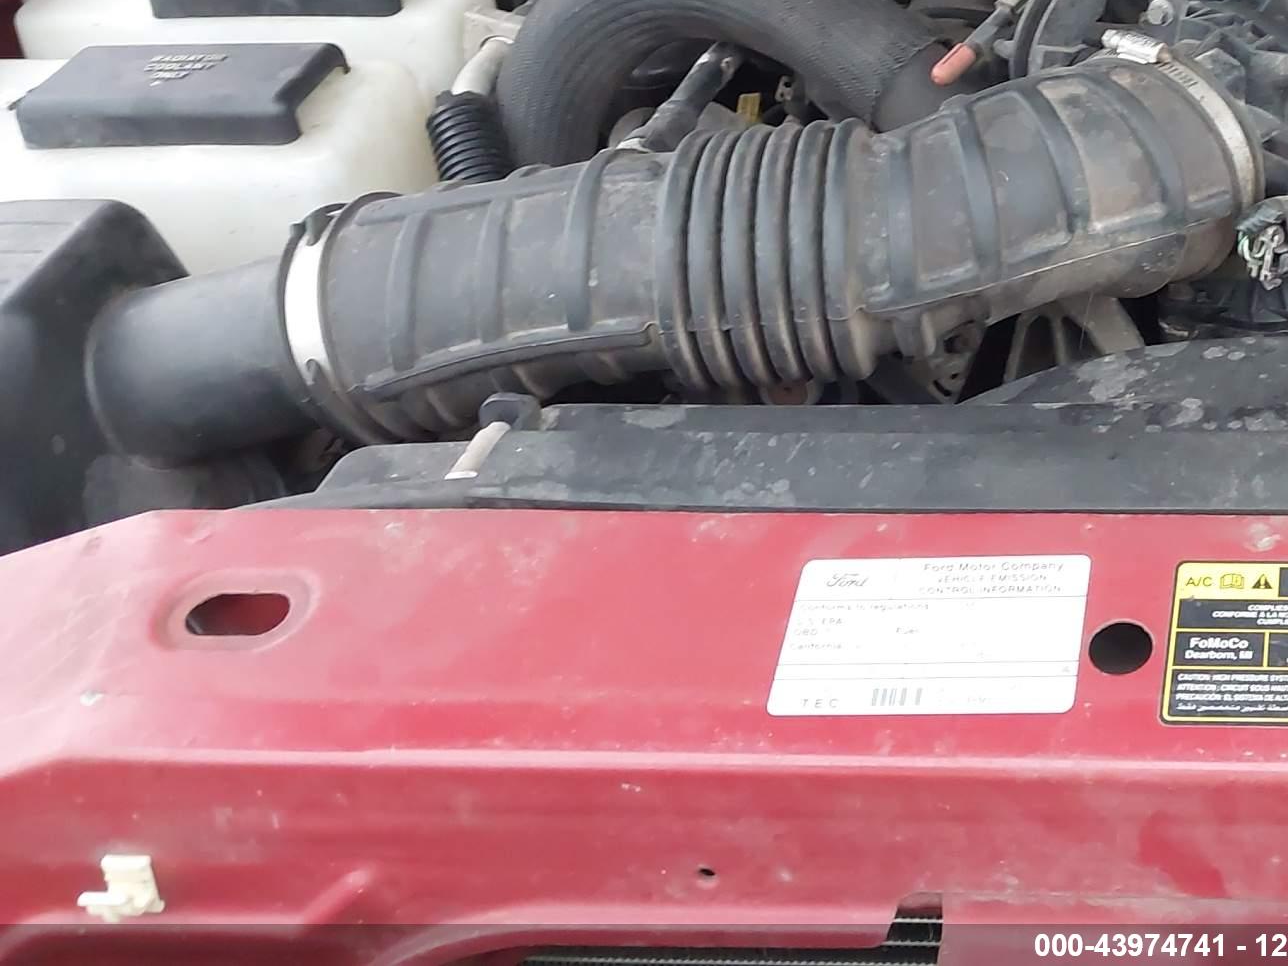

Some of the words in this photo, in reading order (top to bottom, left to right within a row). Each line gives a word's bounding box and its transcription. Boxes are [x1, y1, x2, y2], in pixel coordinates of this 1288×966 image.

[1001, 562, 1064, 571] Company
[826, 573, 869, 587] Ford
[990, 574, 1047, 582] EMISSION
[1186, 576, 1212, 588] A/C
[980, 586, 1061, 594] INFORMATION
[1189, 638, 1249, 649] FoMoCo
[1184, 650, 1238, 660] Dearborn,
[1239, 650, 1254, 660] MI
